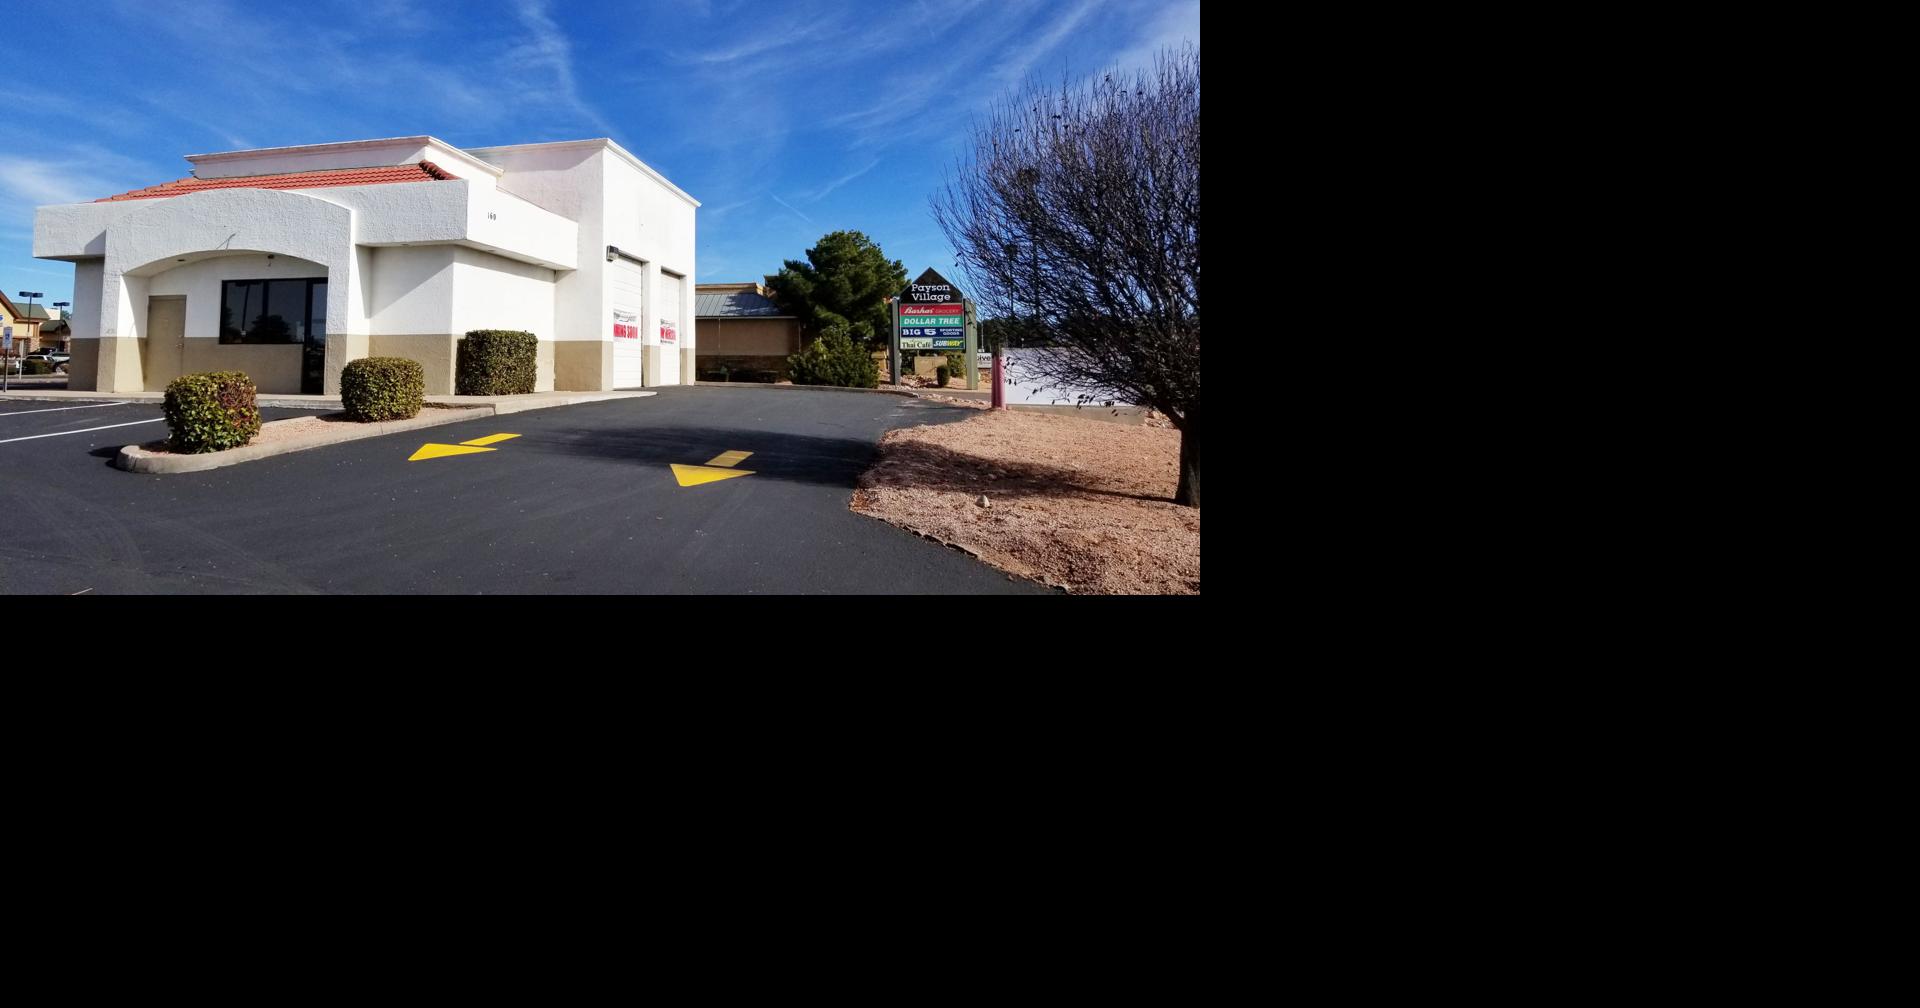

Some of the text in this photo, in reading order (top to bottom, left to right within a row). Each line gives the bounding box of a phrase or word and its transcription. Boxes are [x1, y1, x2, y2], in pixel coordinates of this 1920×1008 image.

[487, 211, 497, 221] 160
[911, 284, 950, 292] Payson
[911, 293, 951, 302] Village
[903, 317, 961, 325] DOLLAR TREE
[902, 328, 937, 336] BIG 5
